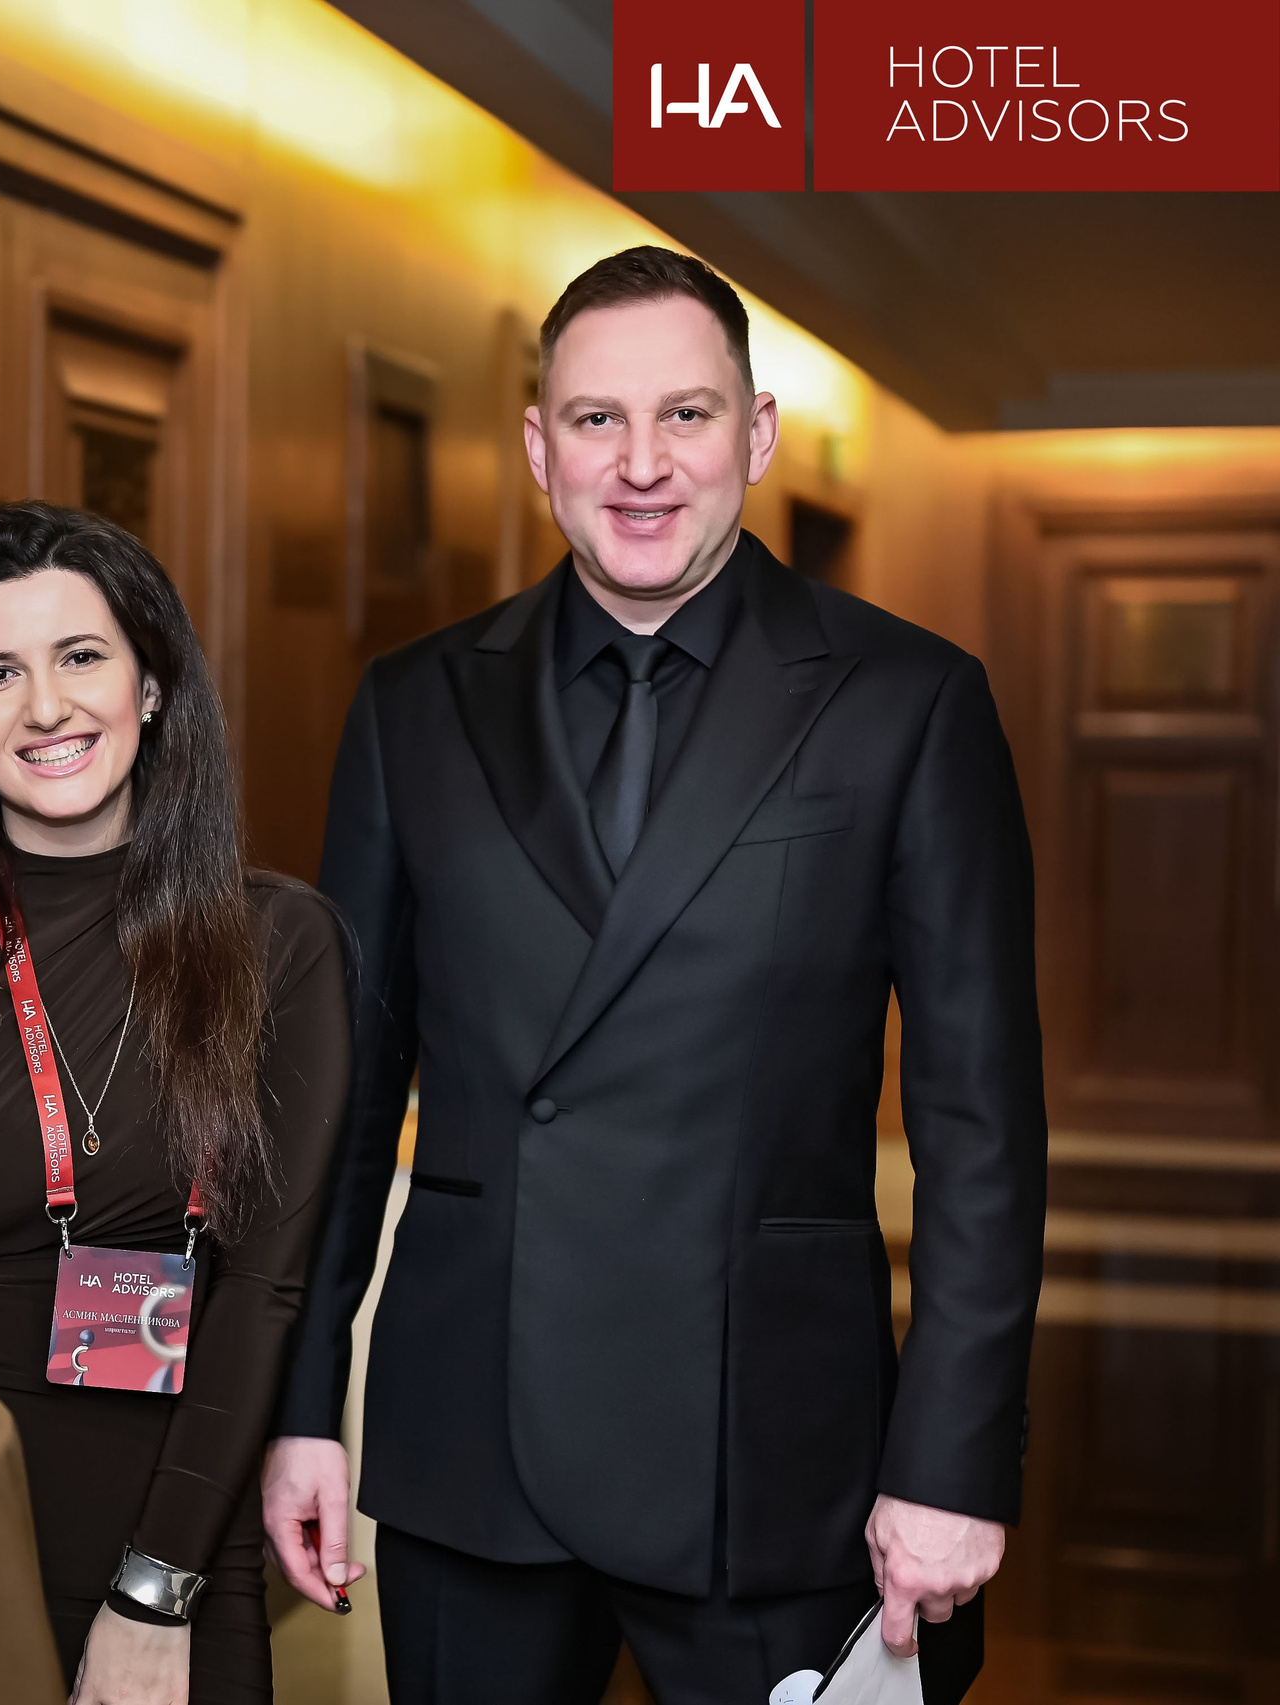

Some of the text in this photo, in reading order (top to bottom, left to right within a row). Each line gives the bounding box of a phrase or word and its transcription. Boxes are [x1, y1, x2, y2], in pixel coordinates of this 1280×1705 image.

[21, 999, 37, 1021] HA
[23, 1026, 43, 1075] ADVISORS
[33, 1024, 48, 1056] HOTEL
[43, 1093, 59, 1118] HA
[56, 1123, 66, 1161] HOTEL
[45, 1125, 60, 1183] ADVISORS
[80, 1274, 102, 1288] HA
[113, 1272, 154, 1285] HOTEL
[111, 1284, 176, 1298] ADVISORS
[62, 1309, 181, 1328] АСМИК МАСЛЕННИКОВА
